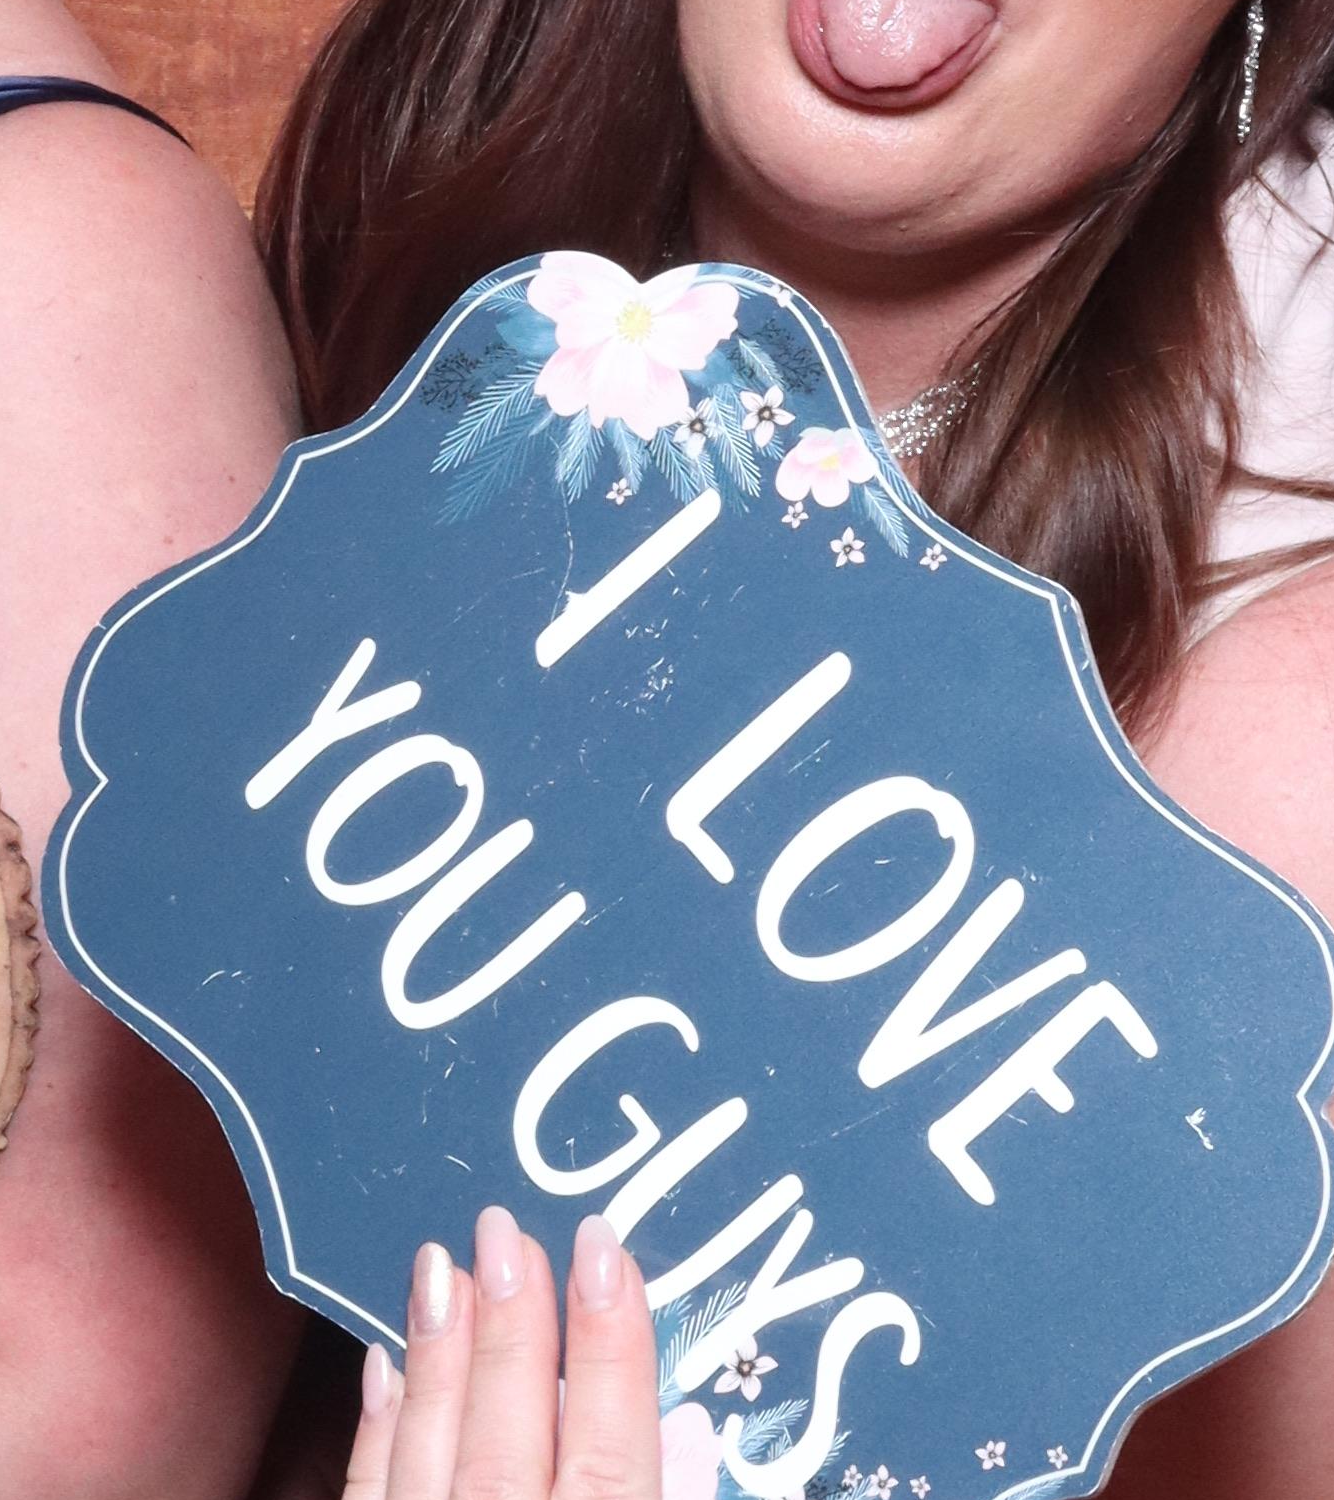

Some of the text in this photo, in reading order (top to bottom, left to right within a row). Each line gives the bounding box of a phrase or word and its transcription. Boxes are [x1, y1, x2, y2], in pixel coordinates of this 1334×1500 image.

[246, 638, 920, 1498] YOU GUYS
[535, 488, 1158, 1206] I LOVE
